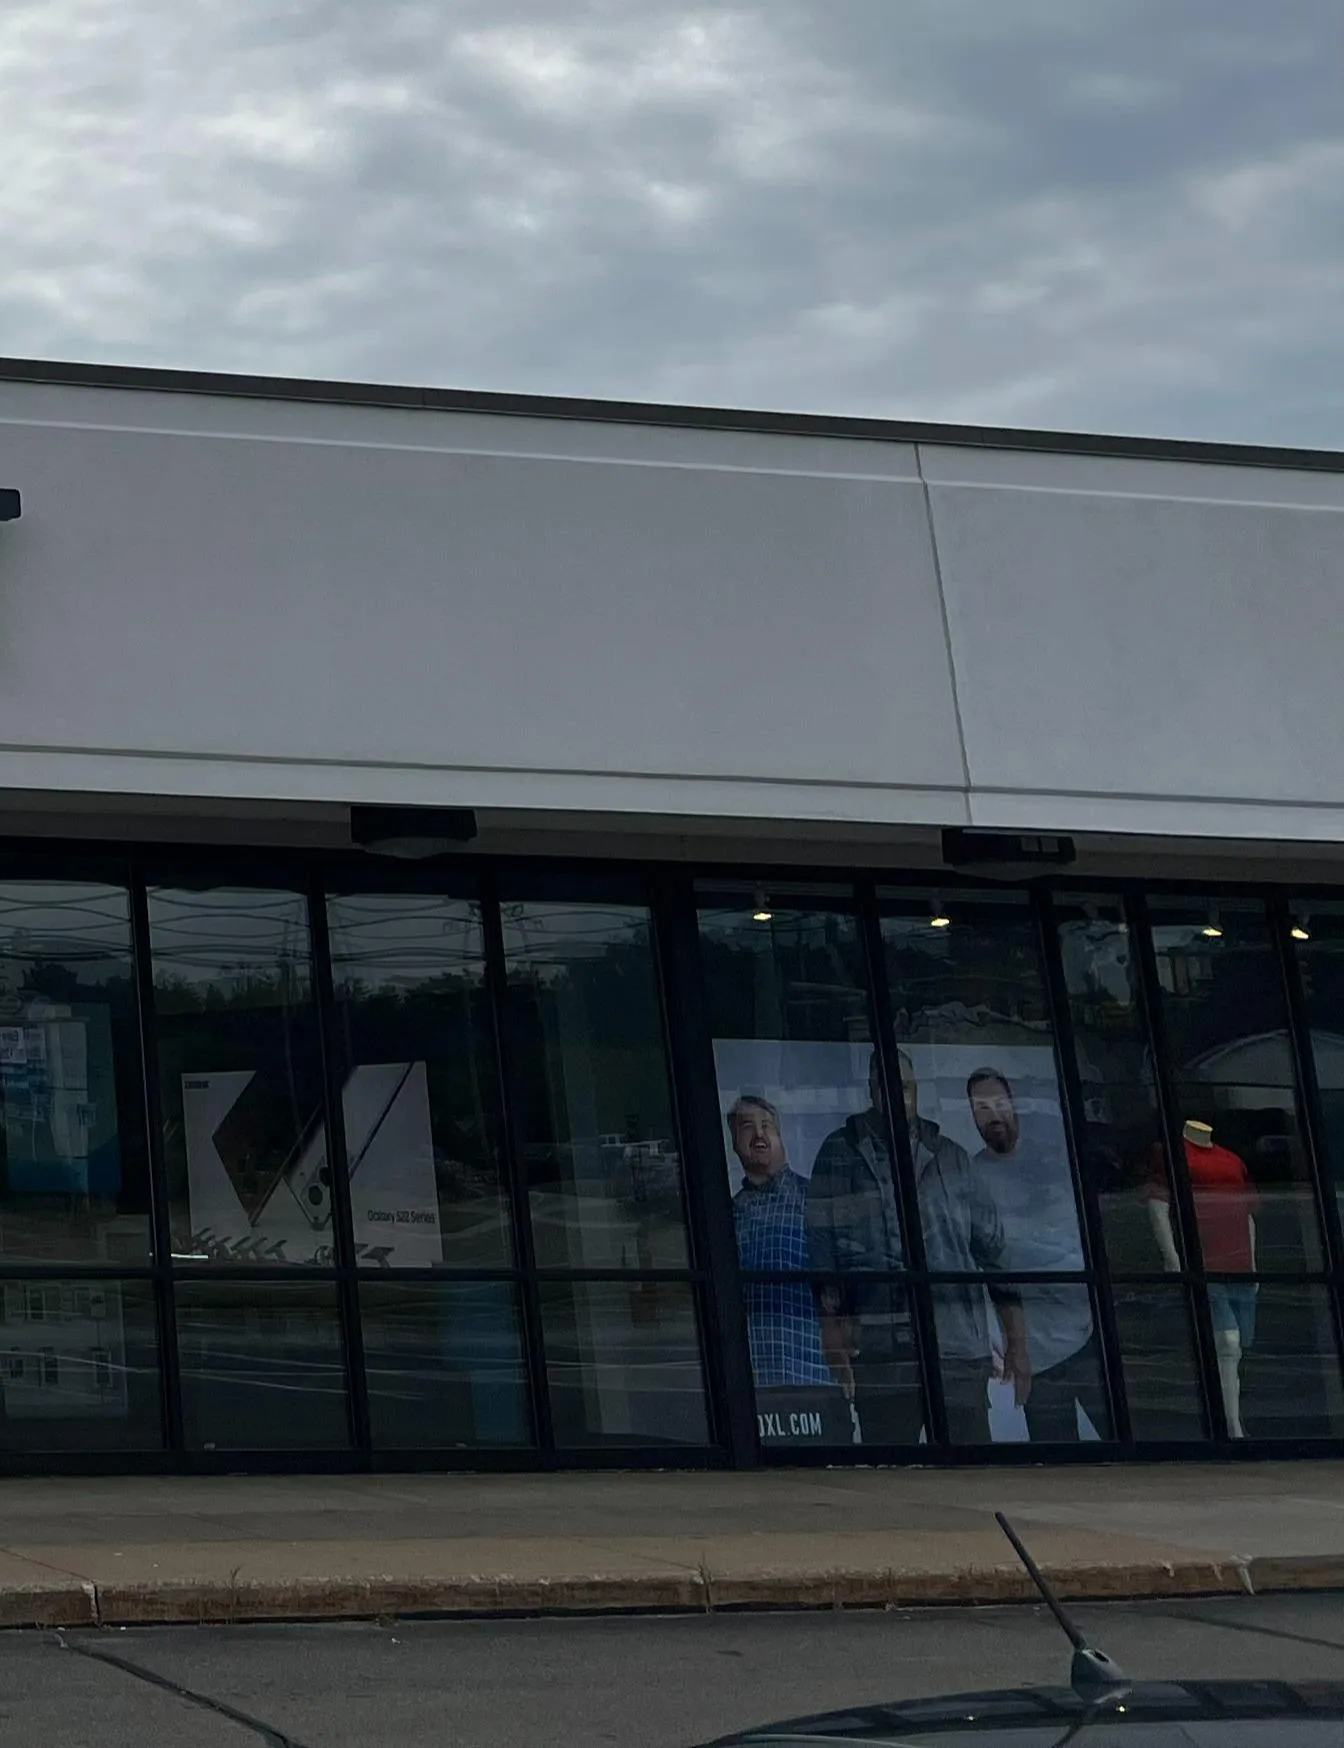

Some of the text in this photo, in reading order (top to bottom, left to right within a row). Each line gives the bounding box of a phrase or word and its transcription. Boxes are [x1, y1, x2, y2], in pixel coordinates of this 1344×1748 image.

[368, 1210, 435, 1225] Galaxy S22 Series
